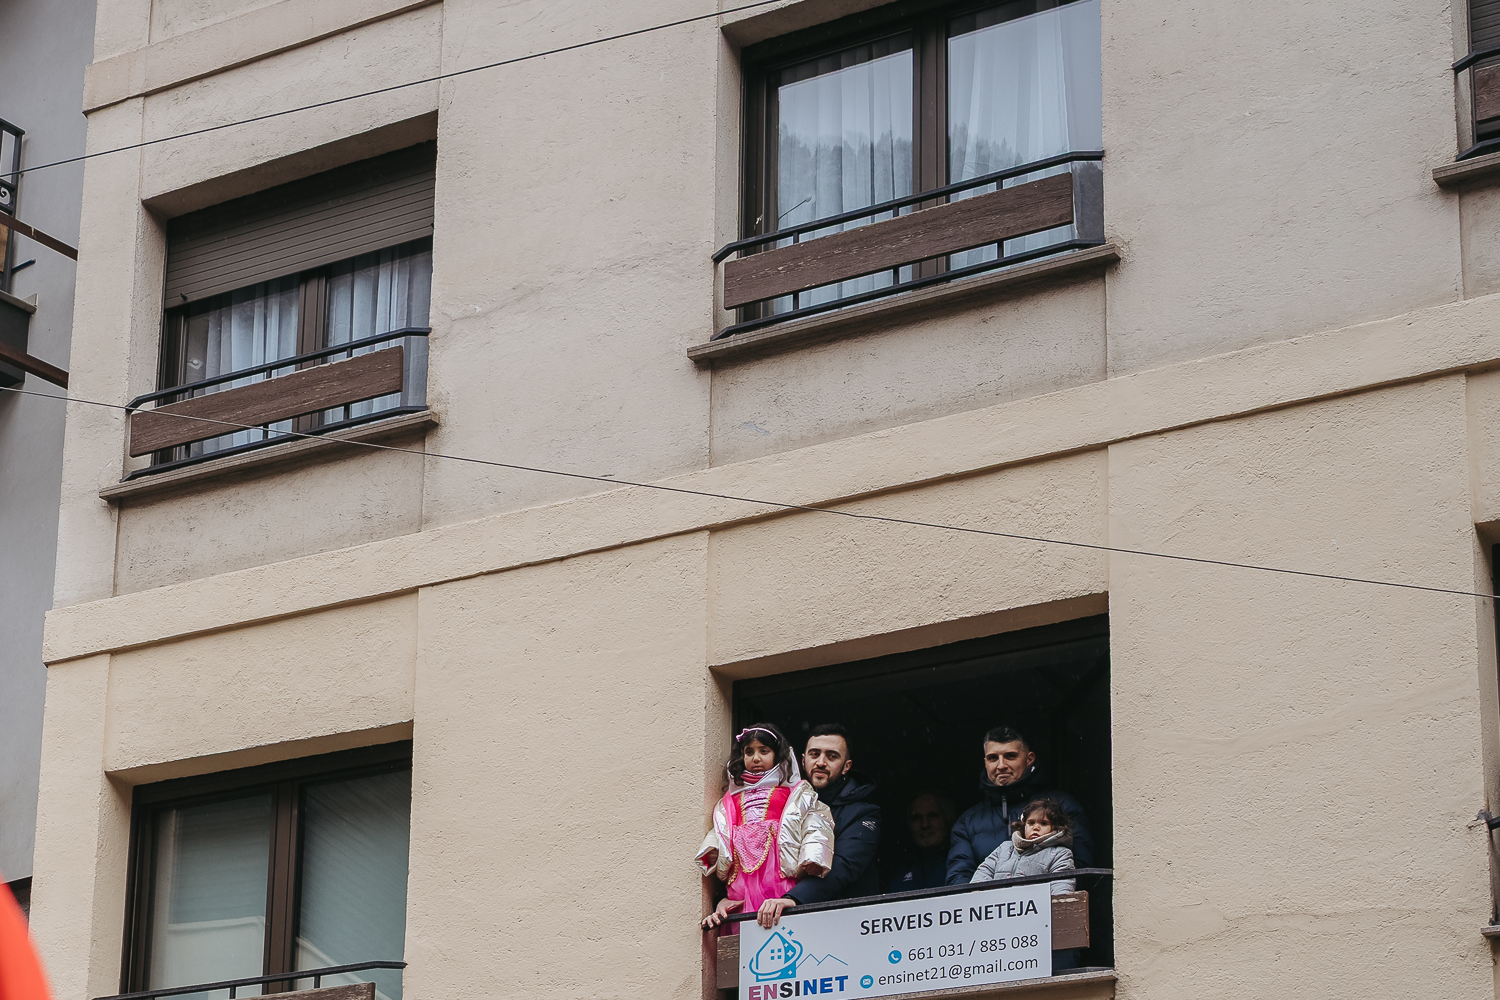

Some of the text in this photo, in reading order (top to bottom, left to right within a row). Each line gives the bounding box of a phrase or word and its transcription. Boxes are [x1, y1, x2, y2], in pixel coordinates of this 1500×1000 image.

[860, 899, 1038, 936] SERVEIS DE NETEJA
[908, 934, 1038, 961] 661 031 / 885 088
[878, 958, 1038, 986] ensinet21@gmail.com
